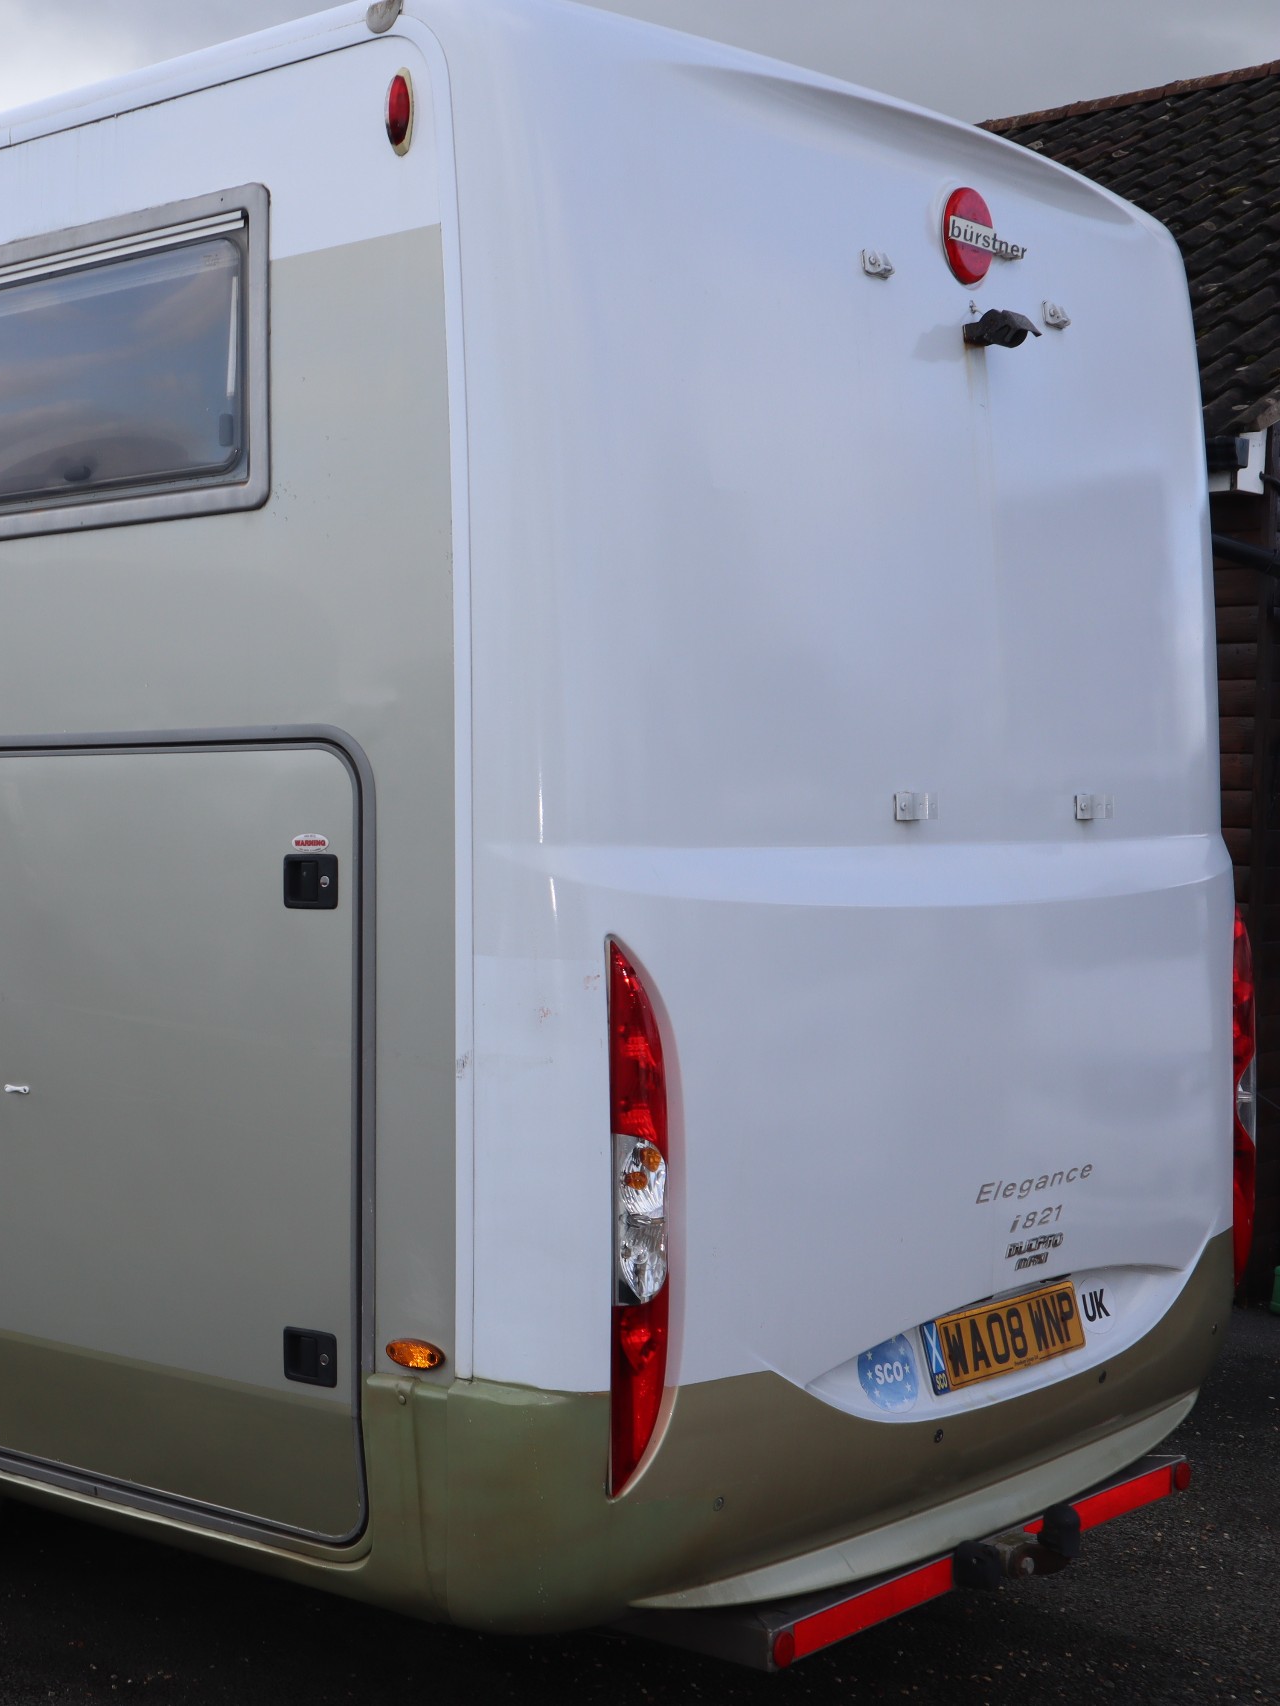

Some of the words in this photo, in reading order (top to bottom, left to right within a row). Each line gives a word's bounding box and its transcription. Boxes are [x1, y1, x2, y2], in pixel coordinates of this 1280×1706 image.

[951, 219, 1027, 259] bürstner
[975, 1163, 1094, 1204] Elegance
[1010, 1204, 1062, 1233] i821
[1081, 1288, 1111, 1323] UK
[943, 1307, 1028, 1378] WA08
[1029, 1290, 1075, 1351] WNP
[874, 1361, 904, 1385] SCO
[935, 1373, 948, 1391] SCO
